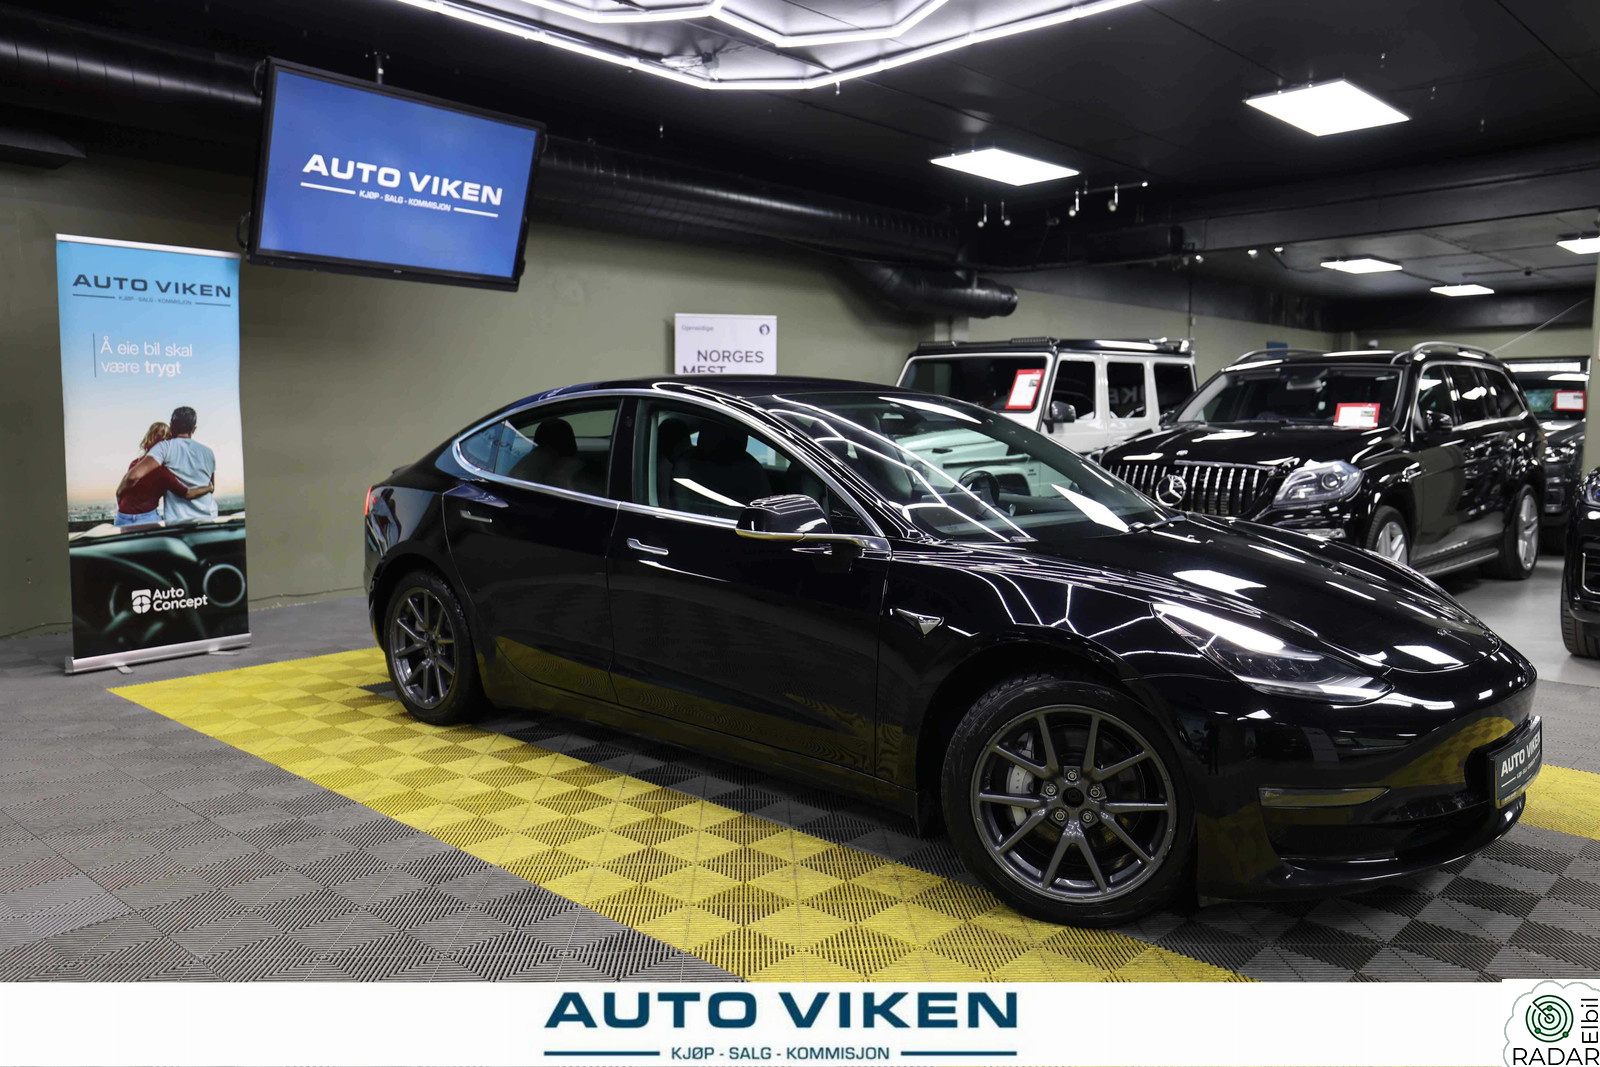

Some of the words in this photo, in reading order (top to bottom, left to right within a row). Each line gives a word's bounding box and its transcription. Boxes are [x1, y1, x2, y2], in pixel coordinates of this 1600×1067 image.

[302, 154, 400, 188] AUTO
[408, 171, 503, 206] VIKEN
[384, 194, 404, 204] SALG
[408, 198, 451, 212] KOMMISJON
[72, 274, 148, 292] AUTO
[155, 280, 231, 298] VIKEN
[100, 335, 113, 354] Å
[117, 341, 139, 355] eie
[144, 342, 161, 356] bil
[165, 344, 193, 358] skal
[697, 349, 765, 363] NORGES
[101, 361, 140, 373] være
[145, 360, 182, 377] trygt
[682, 365, 726, 374] MEST
[152, 587, 185, 600] Auto
[152, 594, 208, 612] Concept
[1501, 748, 1526, 777] AUTO
